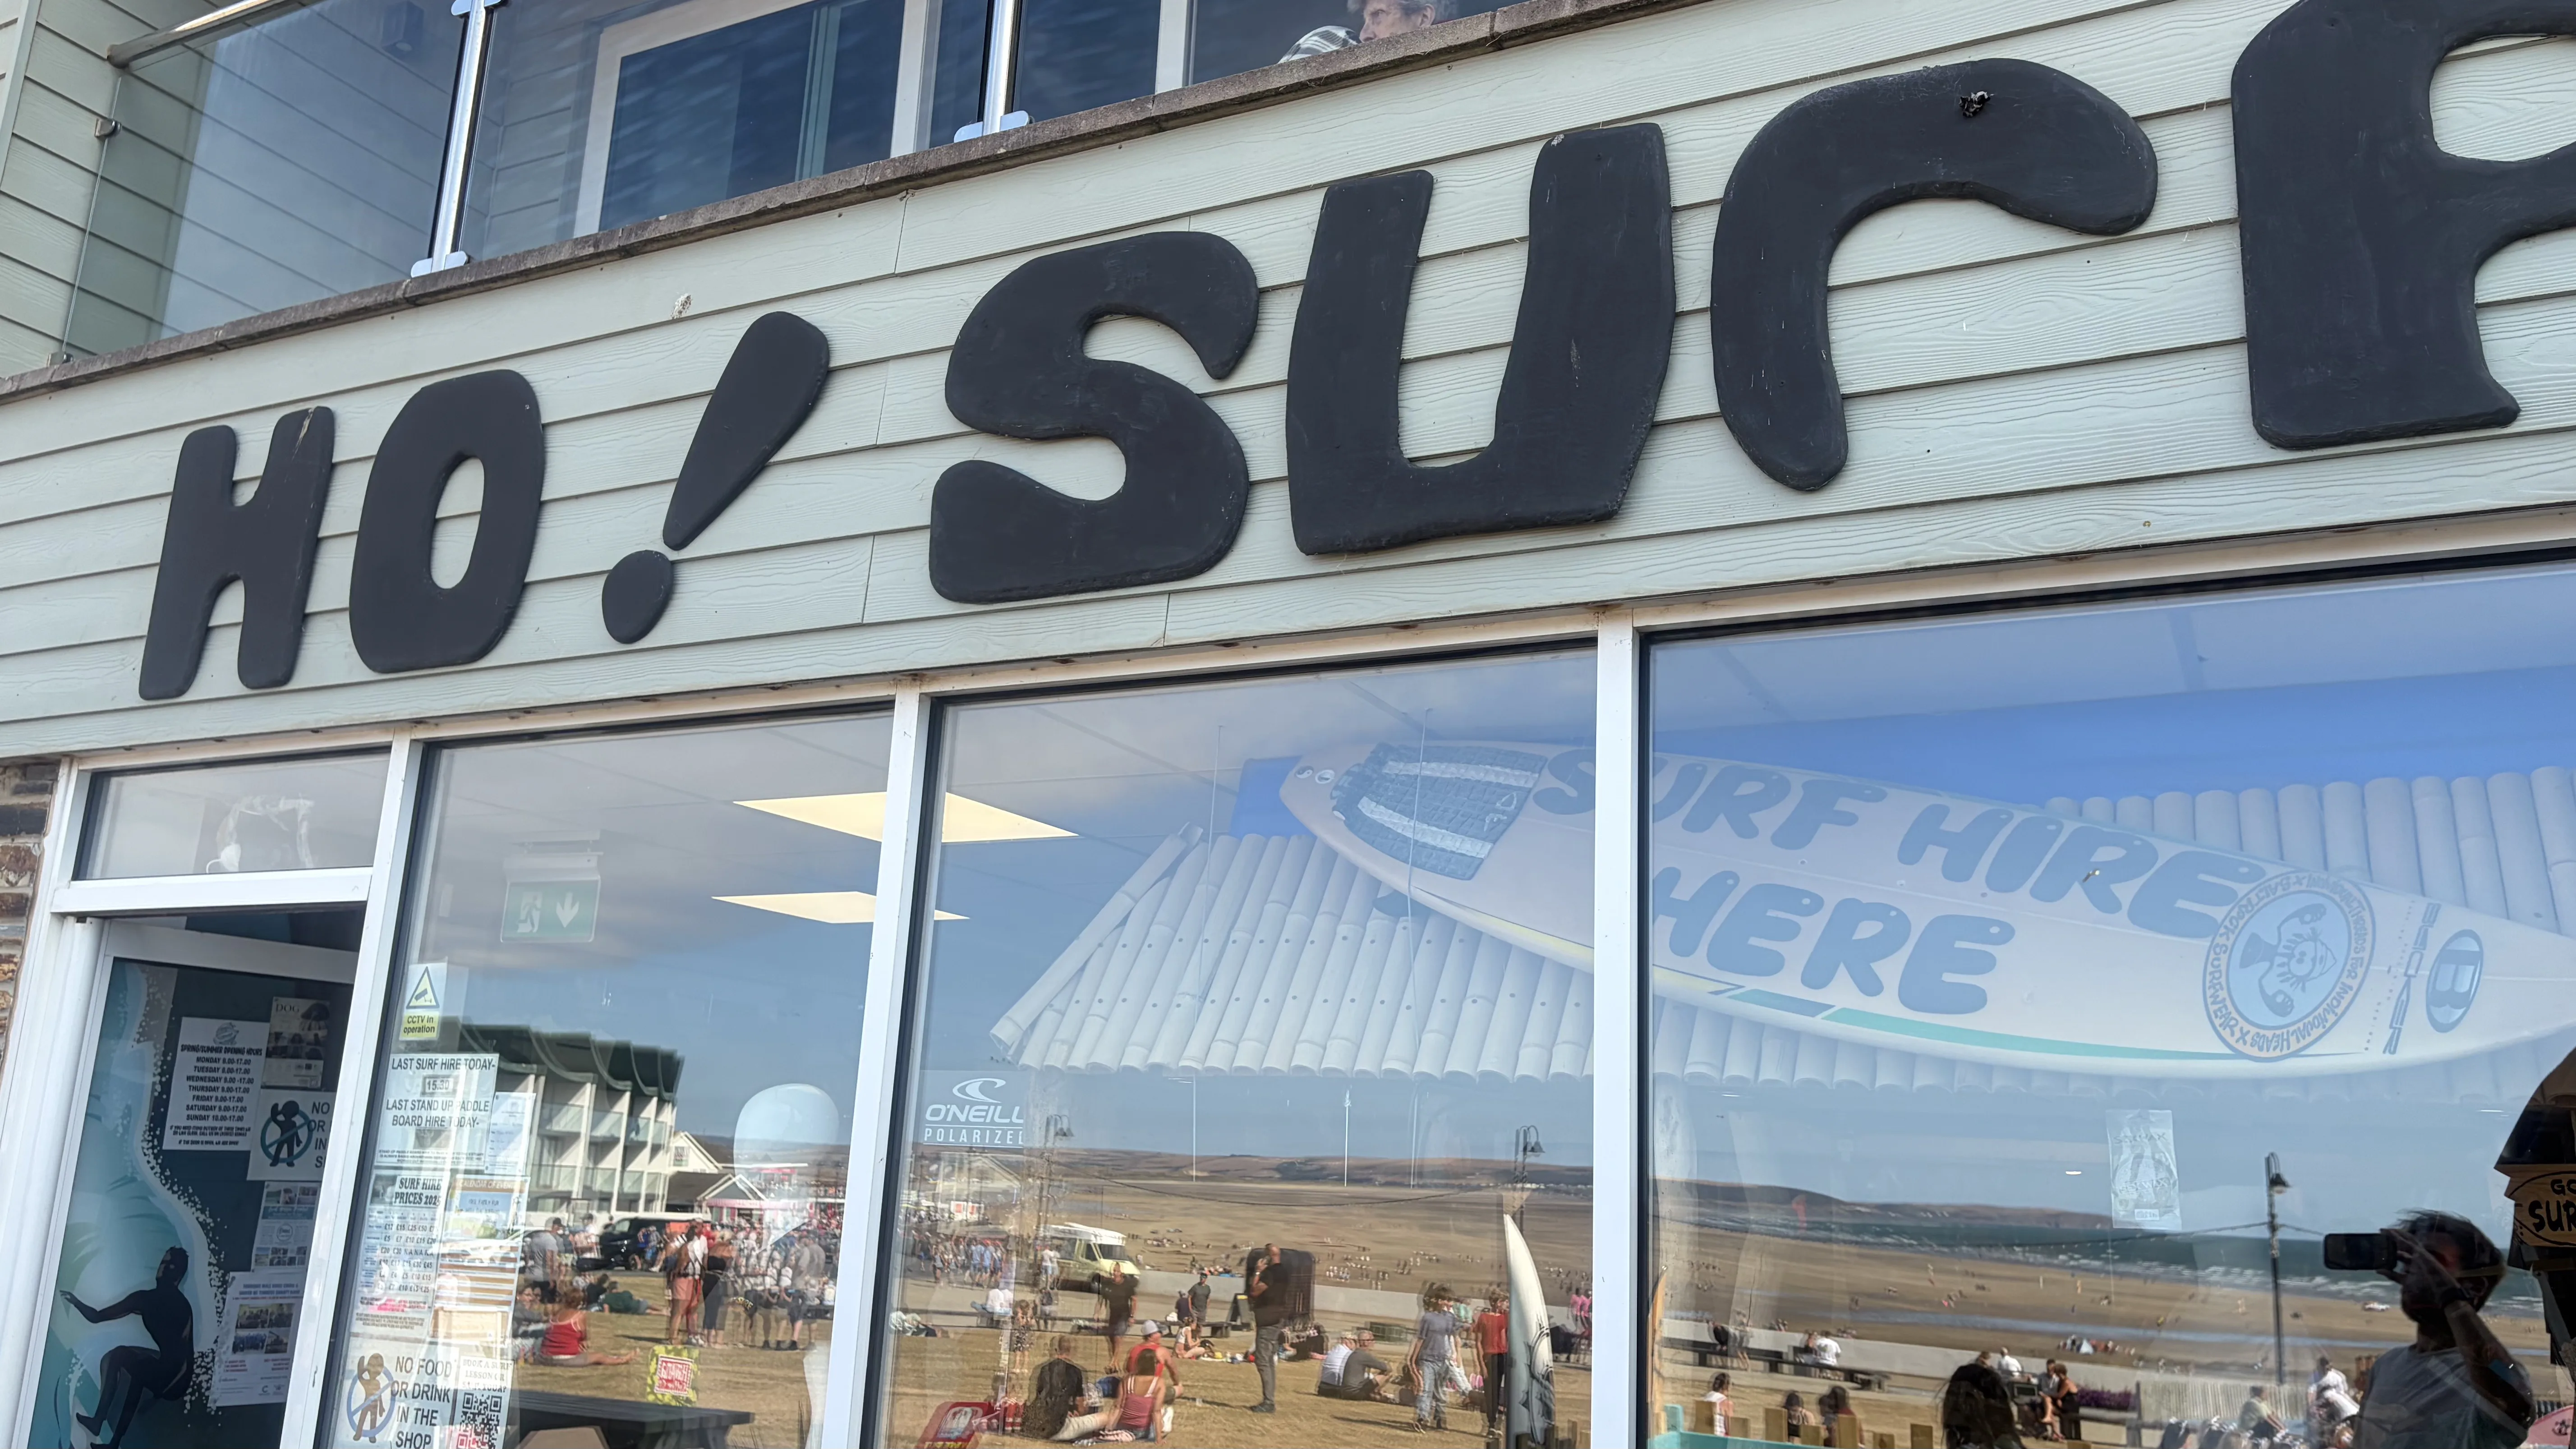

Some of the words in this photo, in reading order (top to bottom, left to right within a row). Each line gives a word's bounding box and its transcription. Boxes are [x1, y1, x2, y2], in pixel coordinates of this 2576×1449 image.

[140, 311, 829, 700] HO!
[1897, 803, 2266, 938] HIRE
[1653, 867, 2015, 1014] HERE
[407, 1016, 425, 1024] CCTV
[403, 1025, 435, 1035] operation
[392, 1058, 414, 1070] LAST
[416, 1058, 439, 1070] SURF
[441, 1058, 461, 1070] HIRE
[186, 1075, 222, 1083] WEDNESDAY
[312, 1102, 330, 1114] NO
[386, 1099, 409, 1111] LAST
[410, 1099, 438, 1111] STAND
[442, 1100, 453, 1111] UP
[456, 1100, 489, 1112] PADDLE
[925, 1104, 1024, 1123] O'NEILL
[307, 1119, 326, 1132] OR
[392, 1115, 423, 1127] BOARD
[425, 1116, 446, 1127] HIRE
[315, 1138, 327, 1150] IN
[399, 1178, 421, 1190] SURF
[422, 1178, 442, 1191] HIRE
[394, 1192, 423, 1205] PRICES
[424, 1195, 441, 1206] 2025
[396, 1356, 414, 1374] NO
[417, 1358, 451, 1377] FOOD
[391, 1380, 409, 1398] OR
[412, 1383, 450, 1403] DRINK
[397, 1405, 409, 1423] IN
[414, 1408, 438, 1426] THE
[396, 1431, 432, 1449] SHOP
